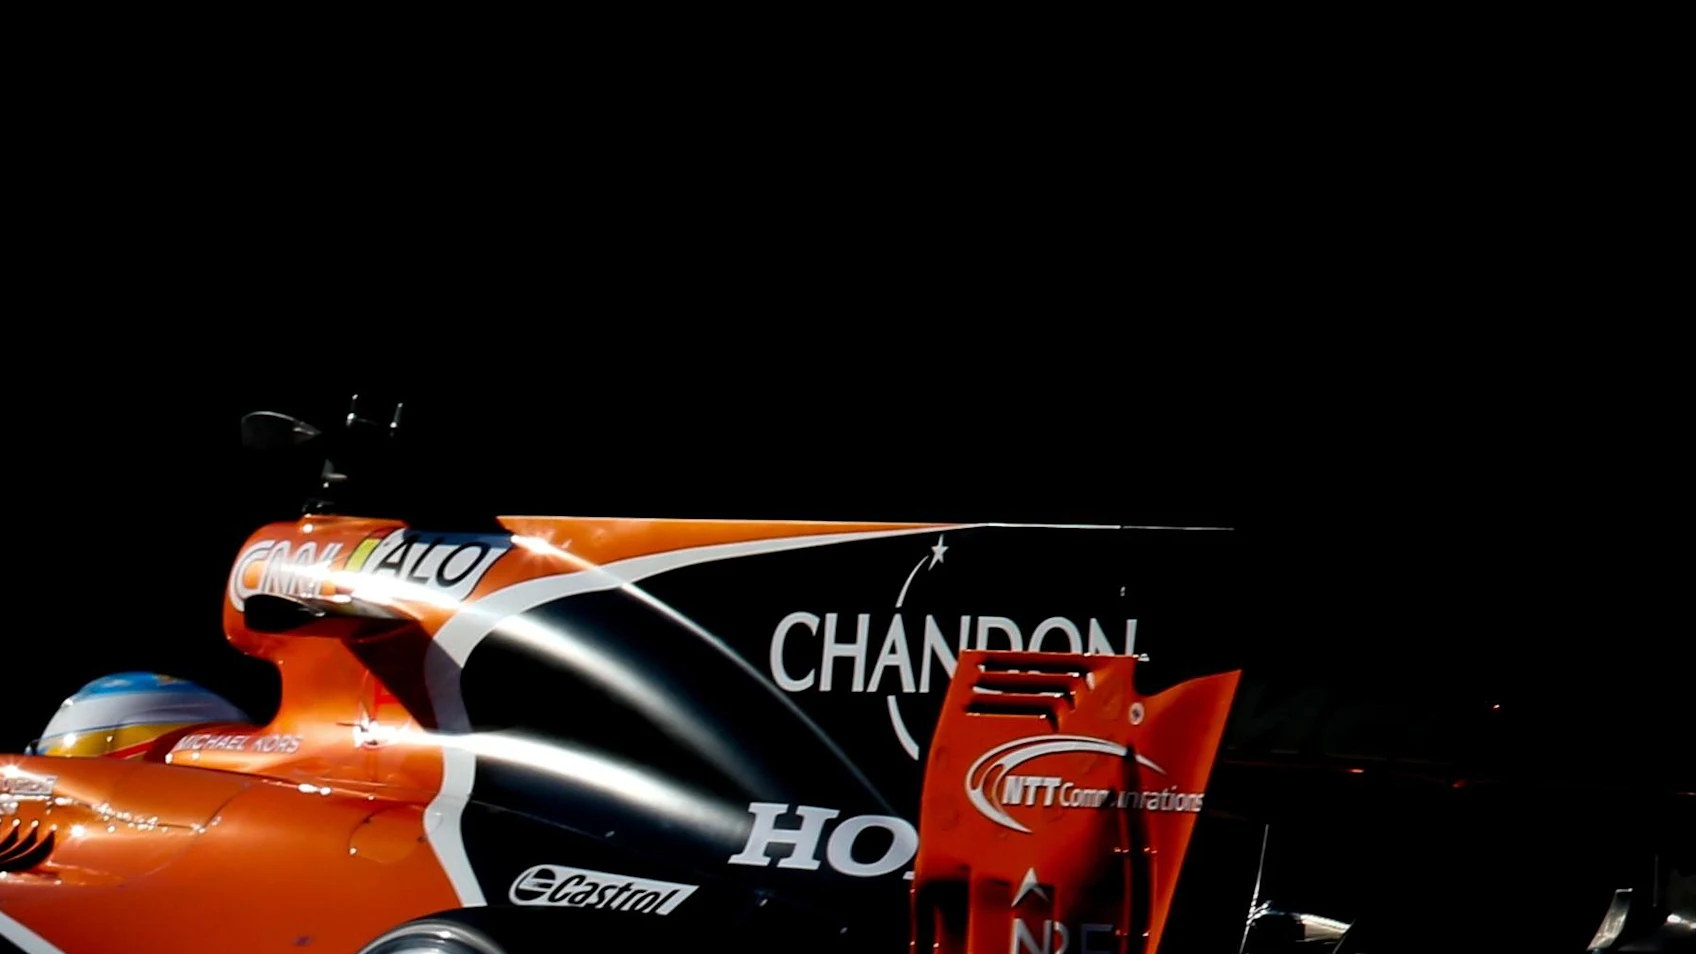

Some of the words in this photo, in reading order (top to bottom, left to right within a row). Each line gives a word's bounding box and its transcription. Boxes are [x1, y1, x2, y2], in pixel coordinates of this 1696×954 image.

[174, 735, 250, 751] MICHAEL
[252, 735, 303, 753] KORS
[1001, 775, 1063, 807] NTT
[1058, 781, 1205, 812] Commniations
[728, 801, 920, 880] HO
[546, 873, 681, 914] Castrol
